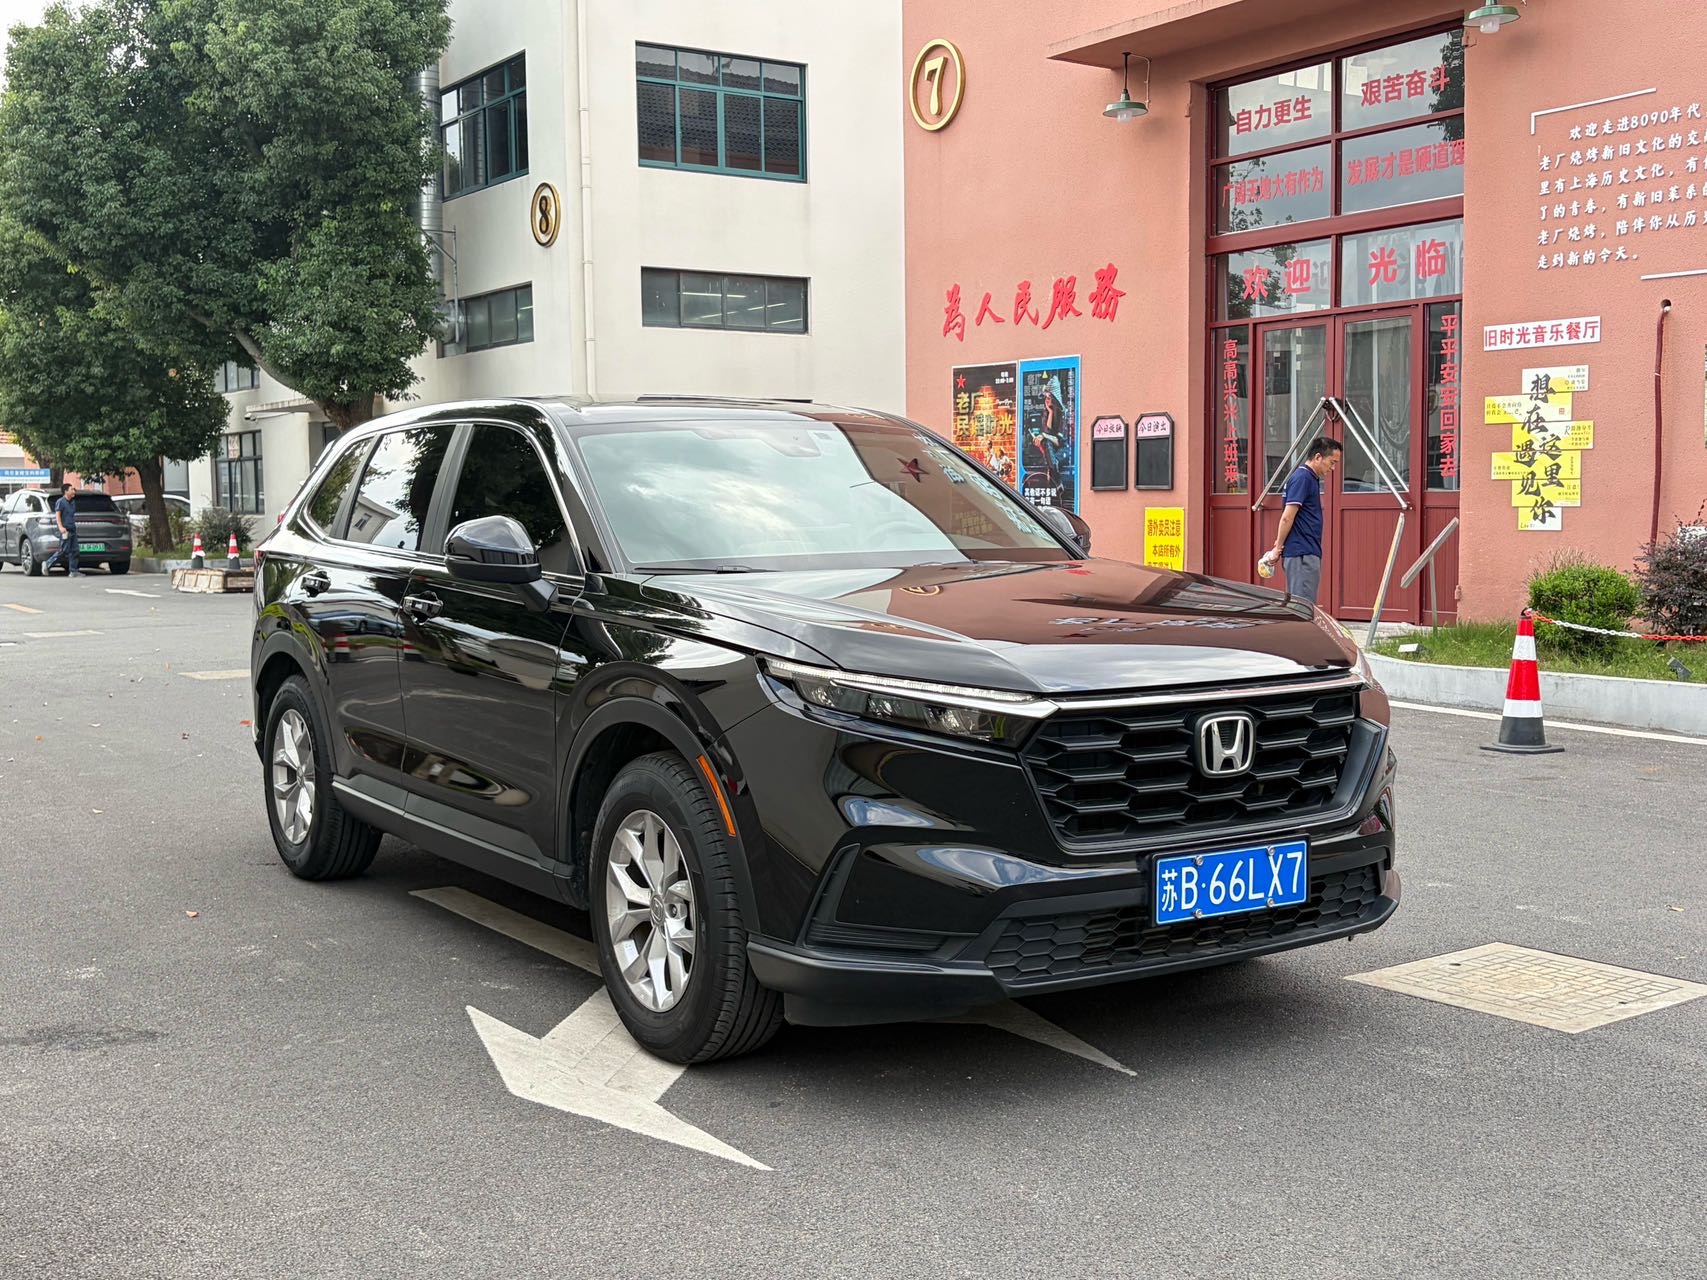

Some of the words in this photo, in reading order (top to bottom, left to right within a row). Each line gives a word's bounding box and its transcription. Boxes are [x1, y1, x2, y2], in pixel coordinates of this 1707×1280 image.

[924, 56, 948, 117] 7
[1361, 64, 1450, 107] 艰苦奋斗
[1236, 95, 1312, 135] 自力更生
[1569, 103, 1707, 141] 欢迎走进8090年代
[1347, 141, 1465, 186] 发展才是硬道理
[1222, 166, 1325, 208] 广阔天地大有作为
[539, 195, 553, 236] 8
[1242, 258, 1312, 300] 欢迎
[1368, 239, 1447, 286] 光临
[1537, 246, 1640, 271] 走到新的今天。
[1485, 321, 1600, 348] 旧时光音乐餐厅
[956, 391, 984, 413] 老厂
[1224, 339, 1239, 483] 高高兴兴上班来
[1440, 314, 1458, 477] 平平安安回家去
[1161, 851, 1303, 912] 苏B·66LX7
